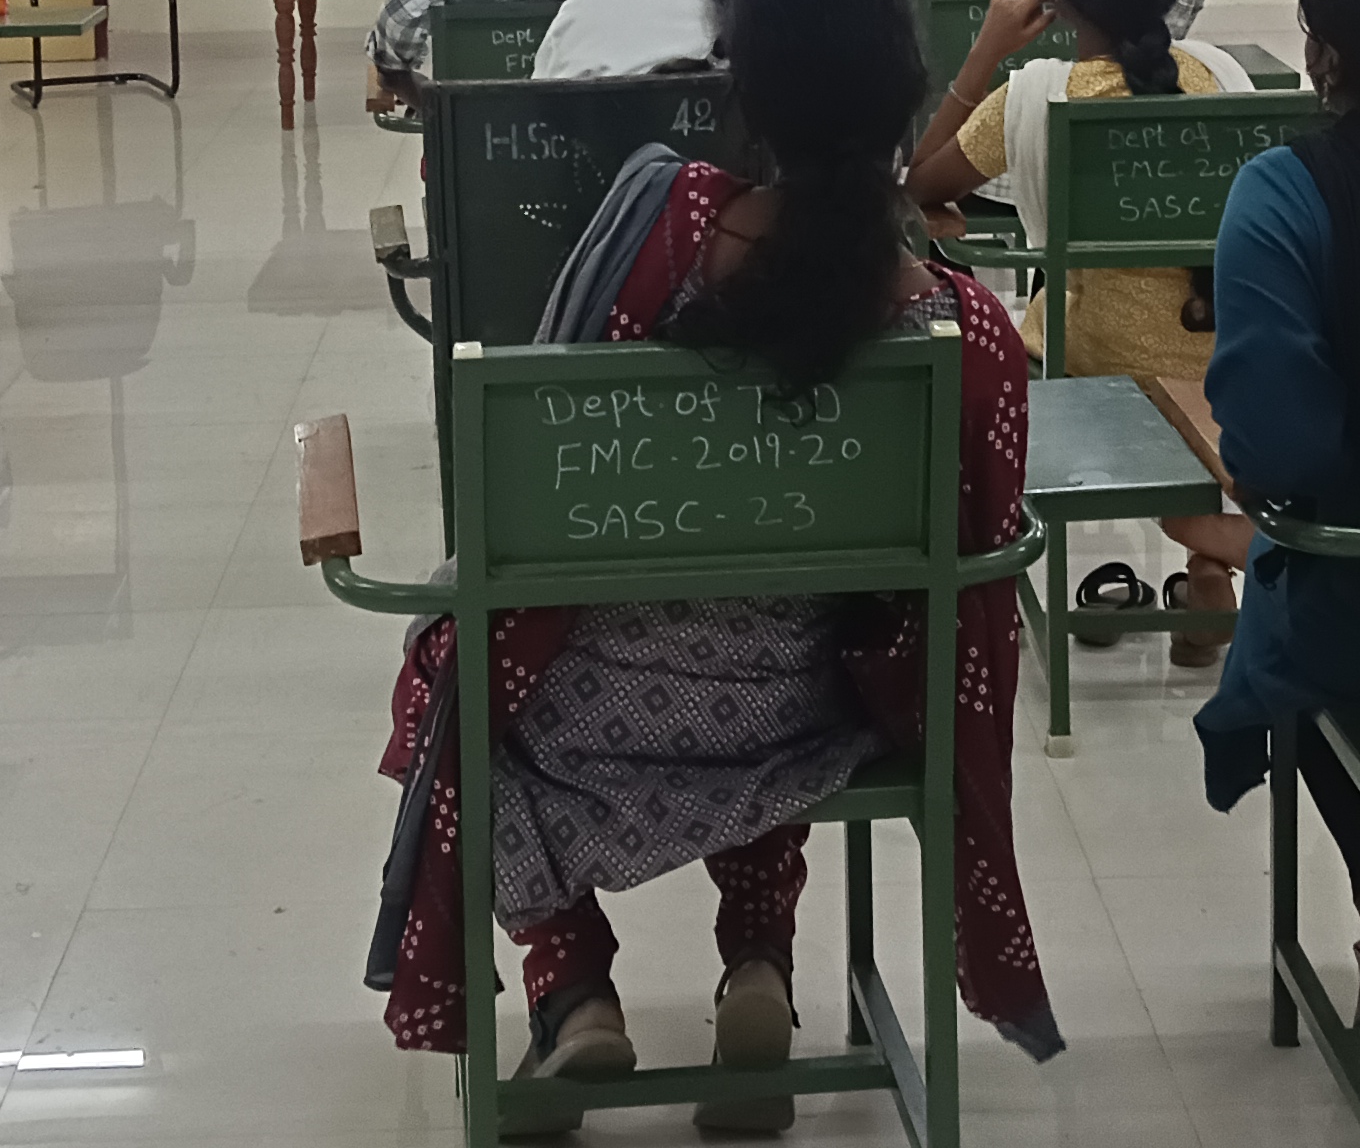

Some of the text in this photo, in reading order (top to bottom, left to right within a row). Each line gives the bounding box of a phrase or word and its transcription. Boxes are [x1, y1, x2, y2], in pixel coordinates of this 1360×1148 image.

[670, 98, 717, 138] 42
[1108, 123, 1167, 150] Dept
[1180, 121, 1211, 152] of
[1111, 160, 1177, 187] FMC
[1119, 195, 1207, 222] SASC
[674, 381, 721, 422] of
[568, 500, 703, 540] SASC
[747, 492, 817, 532] 23
